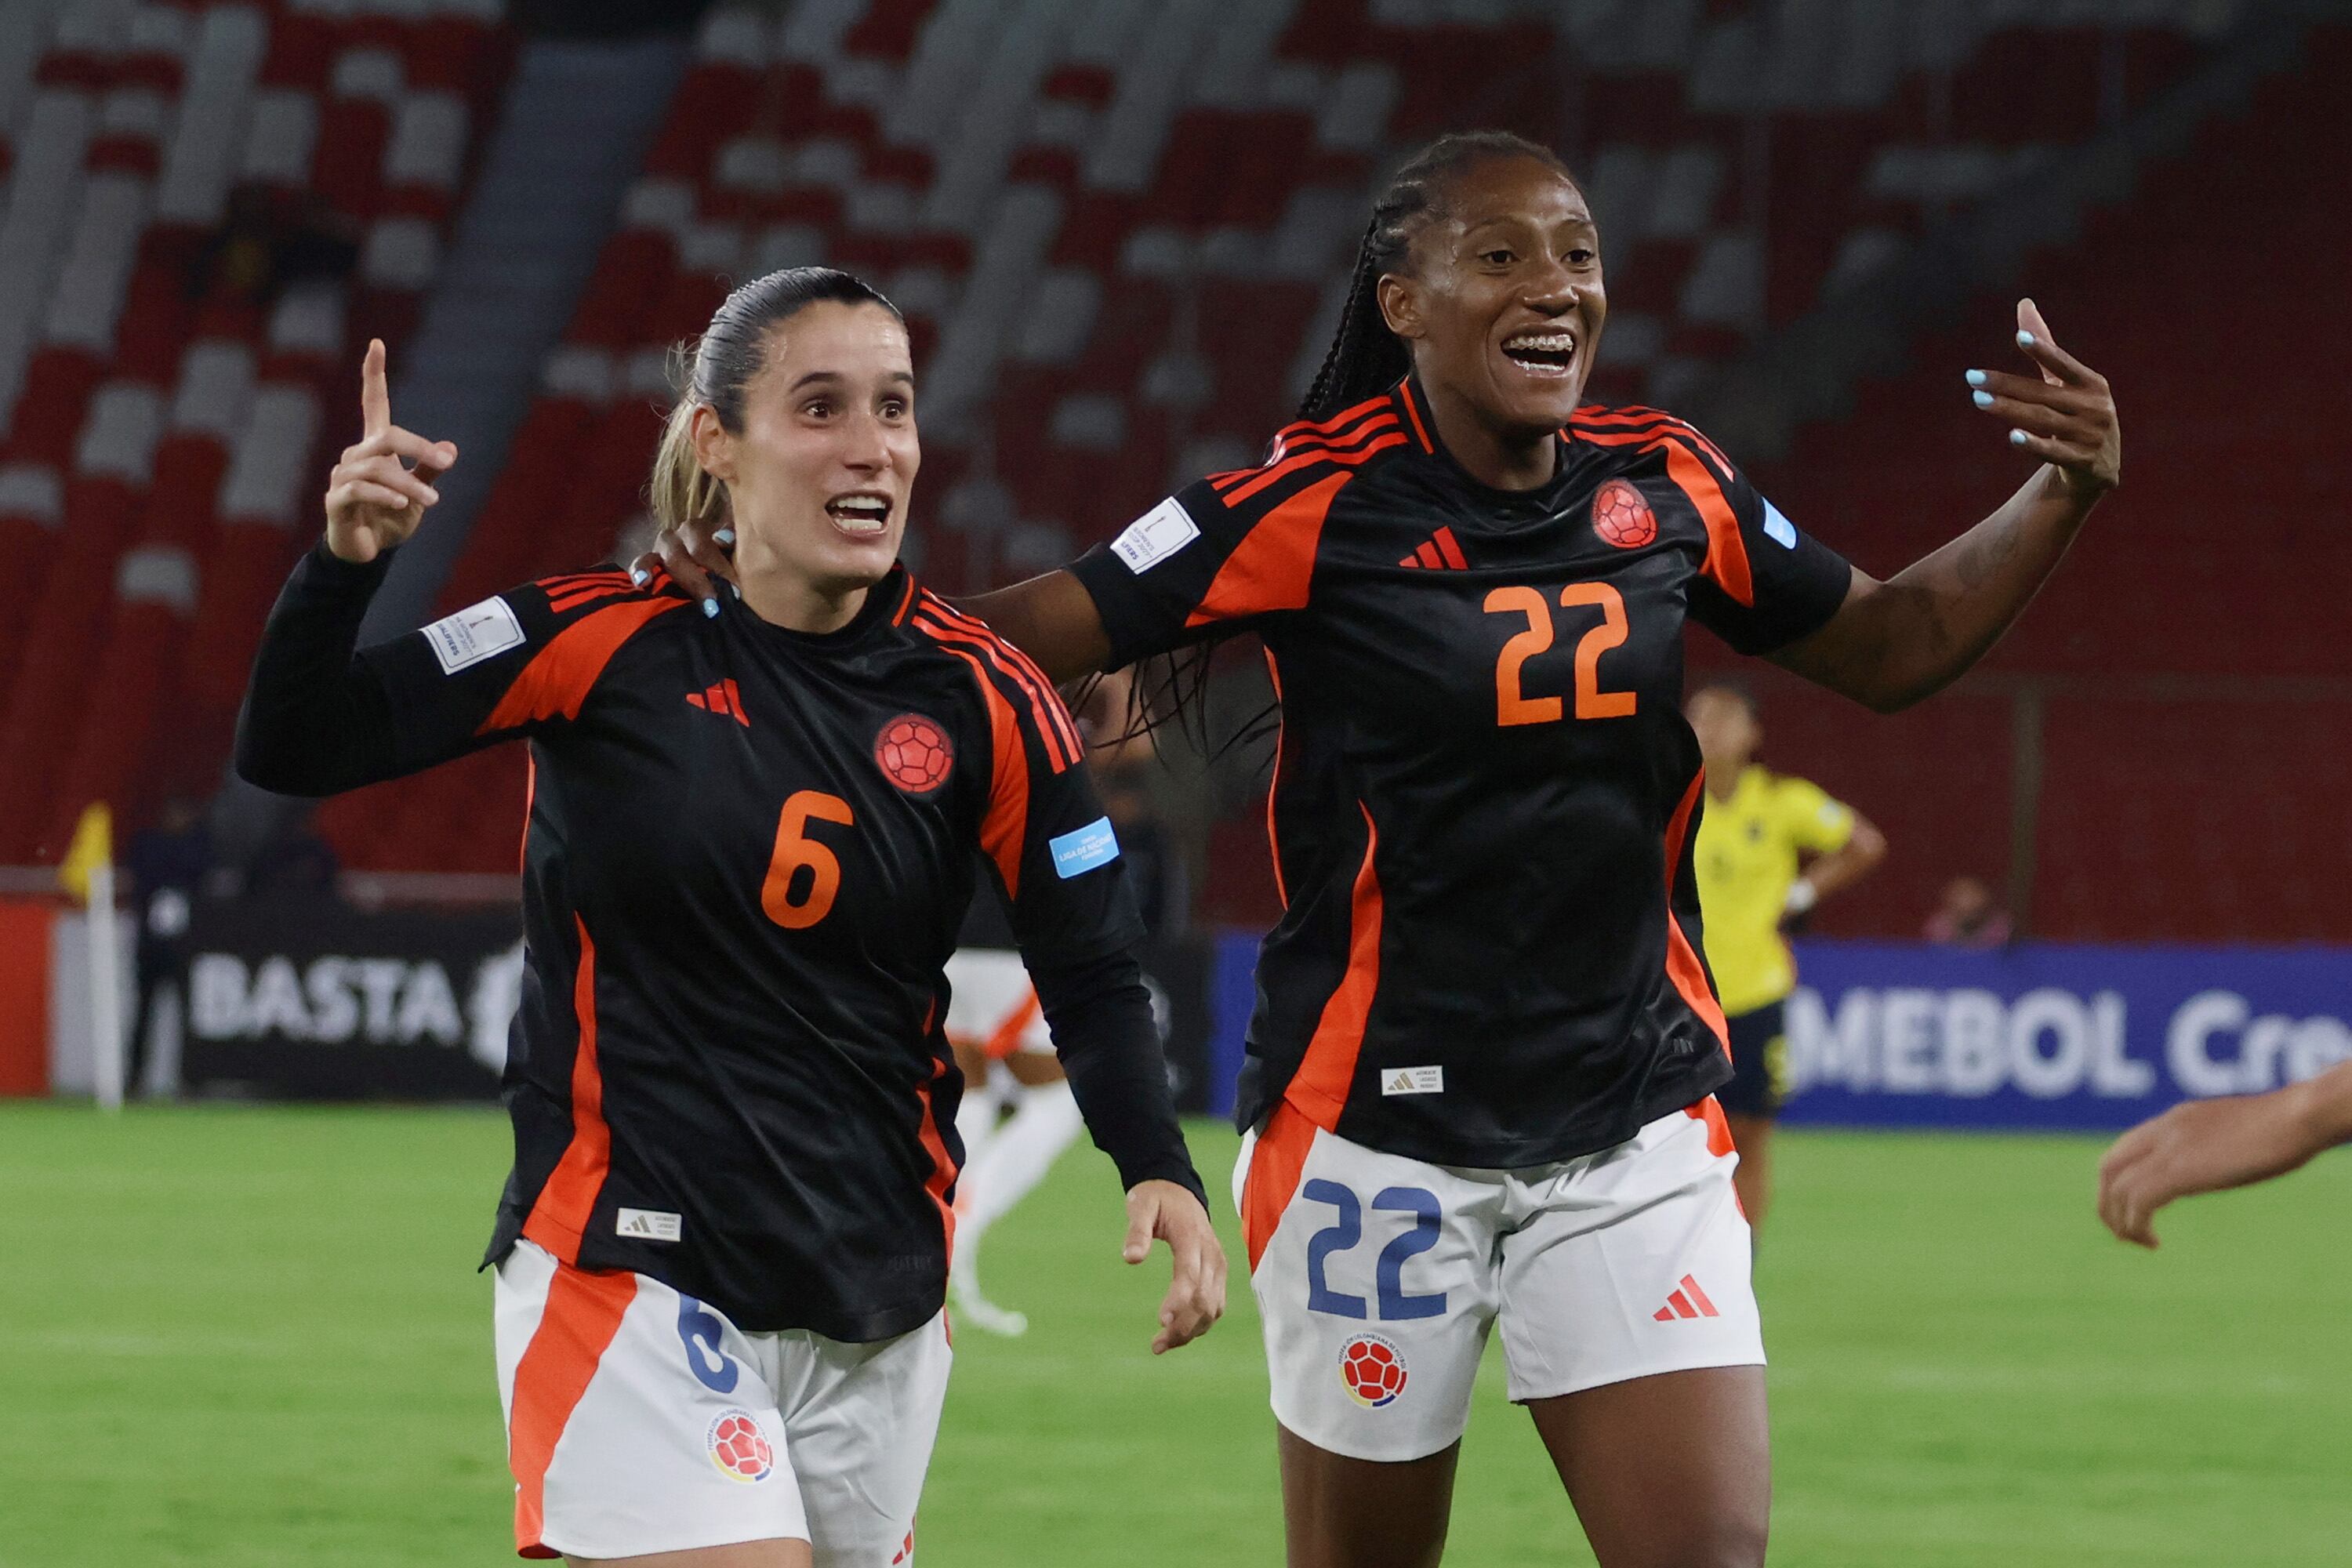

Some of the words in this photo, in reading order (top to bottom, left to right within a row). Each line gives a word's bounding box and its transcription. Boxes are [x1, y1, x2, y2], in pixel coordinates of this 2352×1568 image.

[1483, 581, 1637, 726] 22
[761, 789, 854, 929] 6
[188, 950, 464, 1046] BASTA
[1302, 1178, 1447, 1320] 22
[677, 1292, 739, 1393] 6
